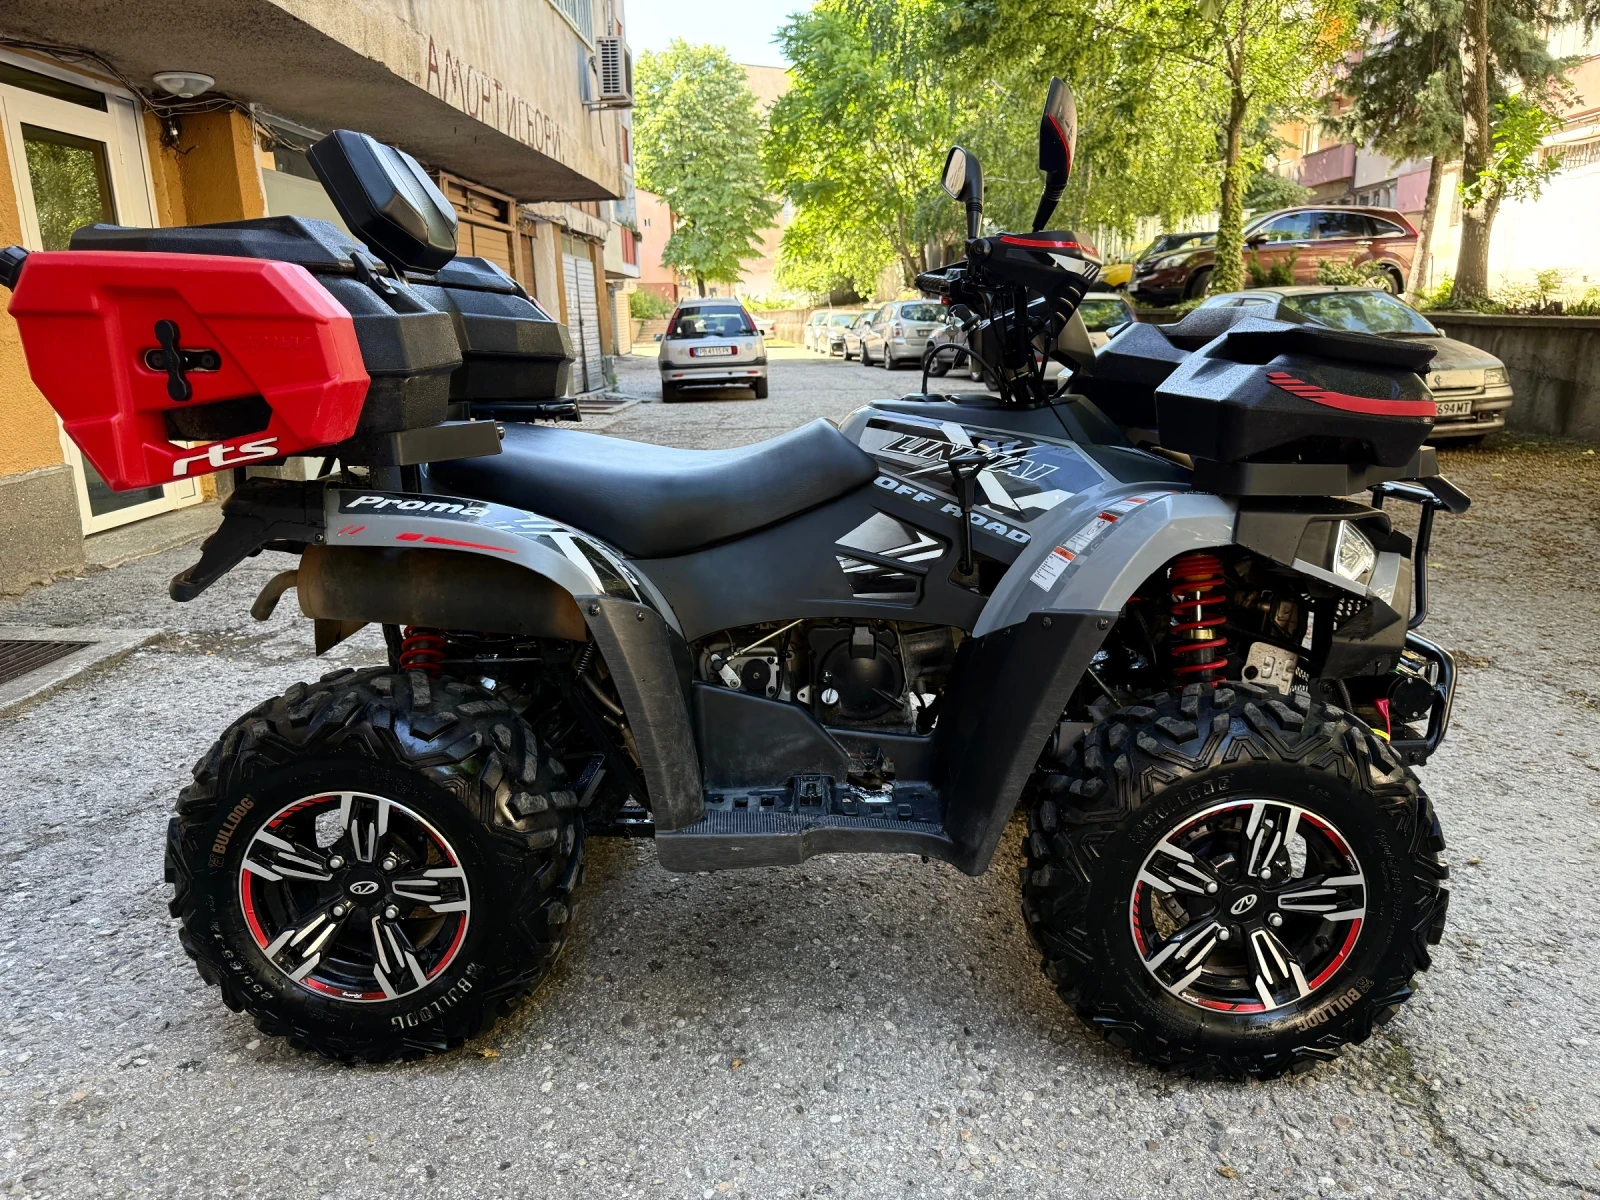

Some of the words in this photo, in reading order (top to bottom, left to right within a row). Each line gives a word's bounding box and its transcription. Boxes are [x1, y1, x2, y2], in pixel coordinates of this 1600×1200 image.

[173, 437, 279, 477] rts
[873, 476, 937, 503] OFF
[941, 503, 1032, 544] ROAD
[212, 798, 256, 855] BULLDOG
[391, 977, 473, 1030] BULLDOG
[1298, 987, 1363, 1032] BULLDOG
